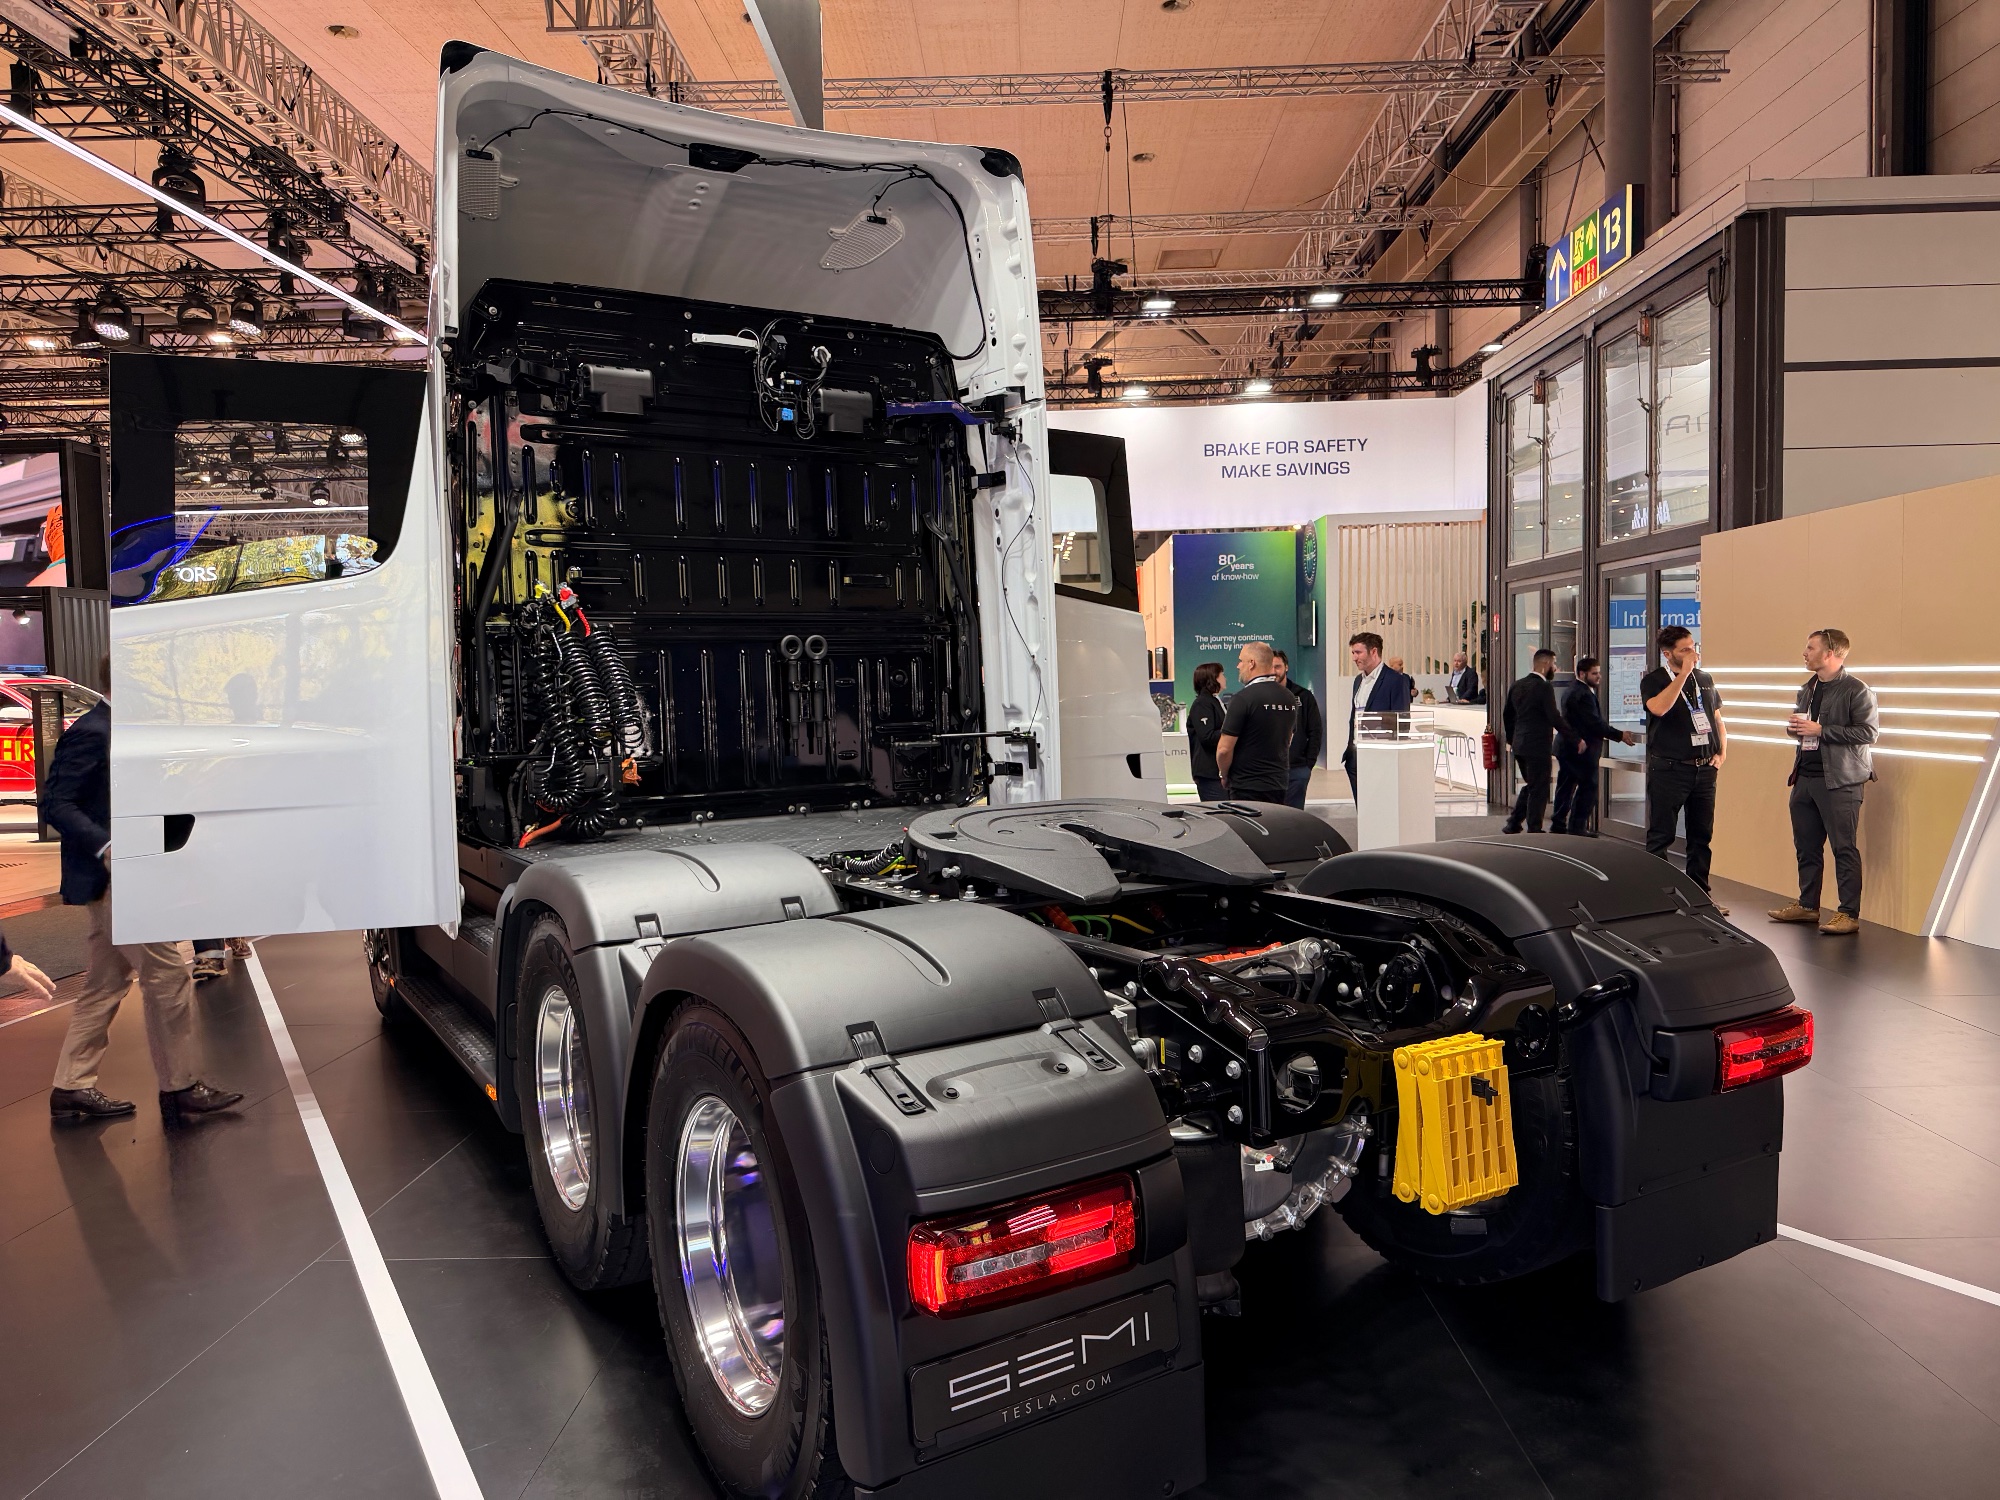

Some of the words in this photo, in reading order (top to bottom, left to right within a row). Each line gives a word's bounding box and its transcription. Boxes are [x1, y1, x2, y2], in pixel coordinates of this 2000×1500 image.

[1603, 207, 1621, 254] 13
[1204, 442, 1261, 457] BRAKE
[1266, 440, 1299, 454] FOR
[1304, 438, 1368, 453] SAFETY
[1221, 464, 1271, 478] MAKE
[1276, 461, 1350, 476] SAVINGS
[1218, 554, 1236, 566] 80
[1230, 562, 1255, 571] years
[175, 567, 217, 582] ORS
[1211, 573, 1219, 581] of
[1623, 609, 1701, 627] Infrmat
[1210, 635, 1237, 643] journey
[1238, 633, 1275, 641] continues,
[1223, 642, 1232, 651] by
[949, 1311, 1151, 1412] SEMI
[1001, 1373, 1112, 1423] TESLA.COM
